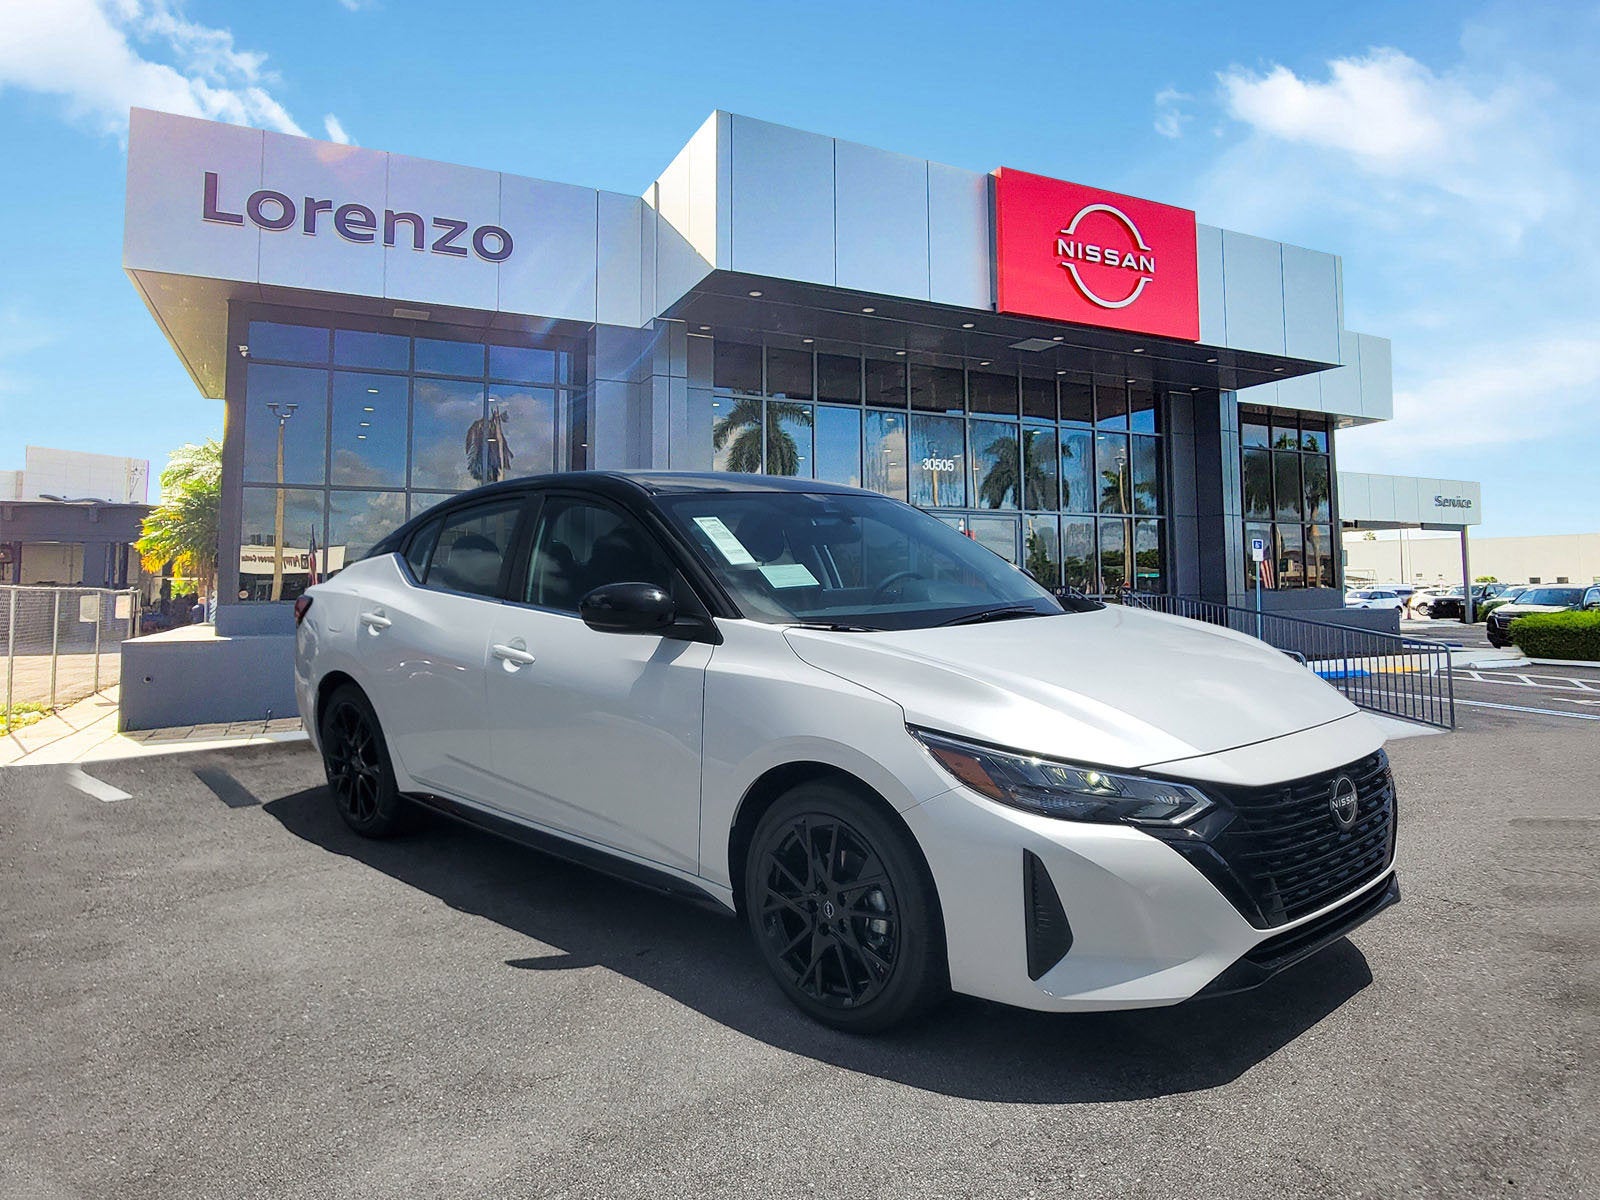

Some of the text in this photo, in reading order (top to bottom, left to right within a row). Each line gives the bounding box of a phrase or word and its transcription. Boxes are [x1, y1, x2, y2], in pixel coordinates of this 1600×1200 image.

[202, 171, 514, 263] Lorenzo
[1057, 238, 1155, 273] NISSAN
[922, 458, 954, 471] 30505
[1434, 495, 1472, 508] Service
